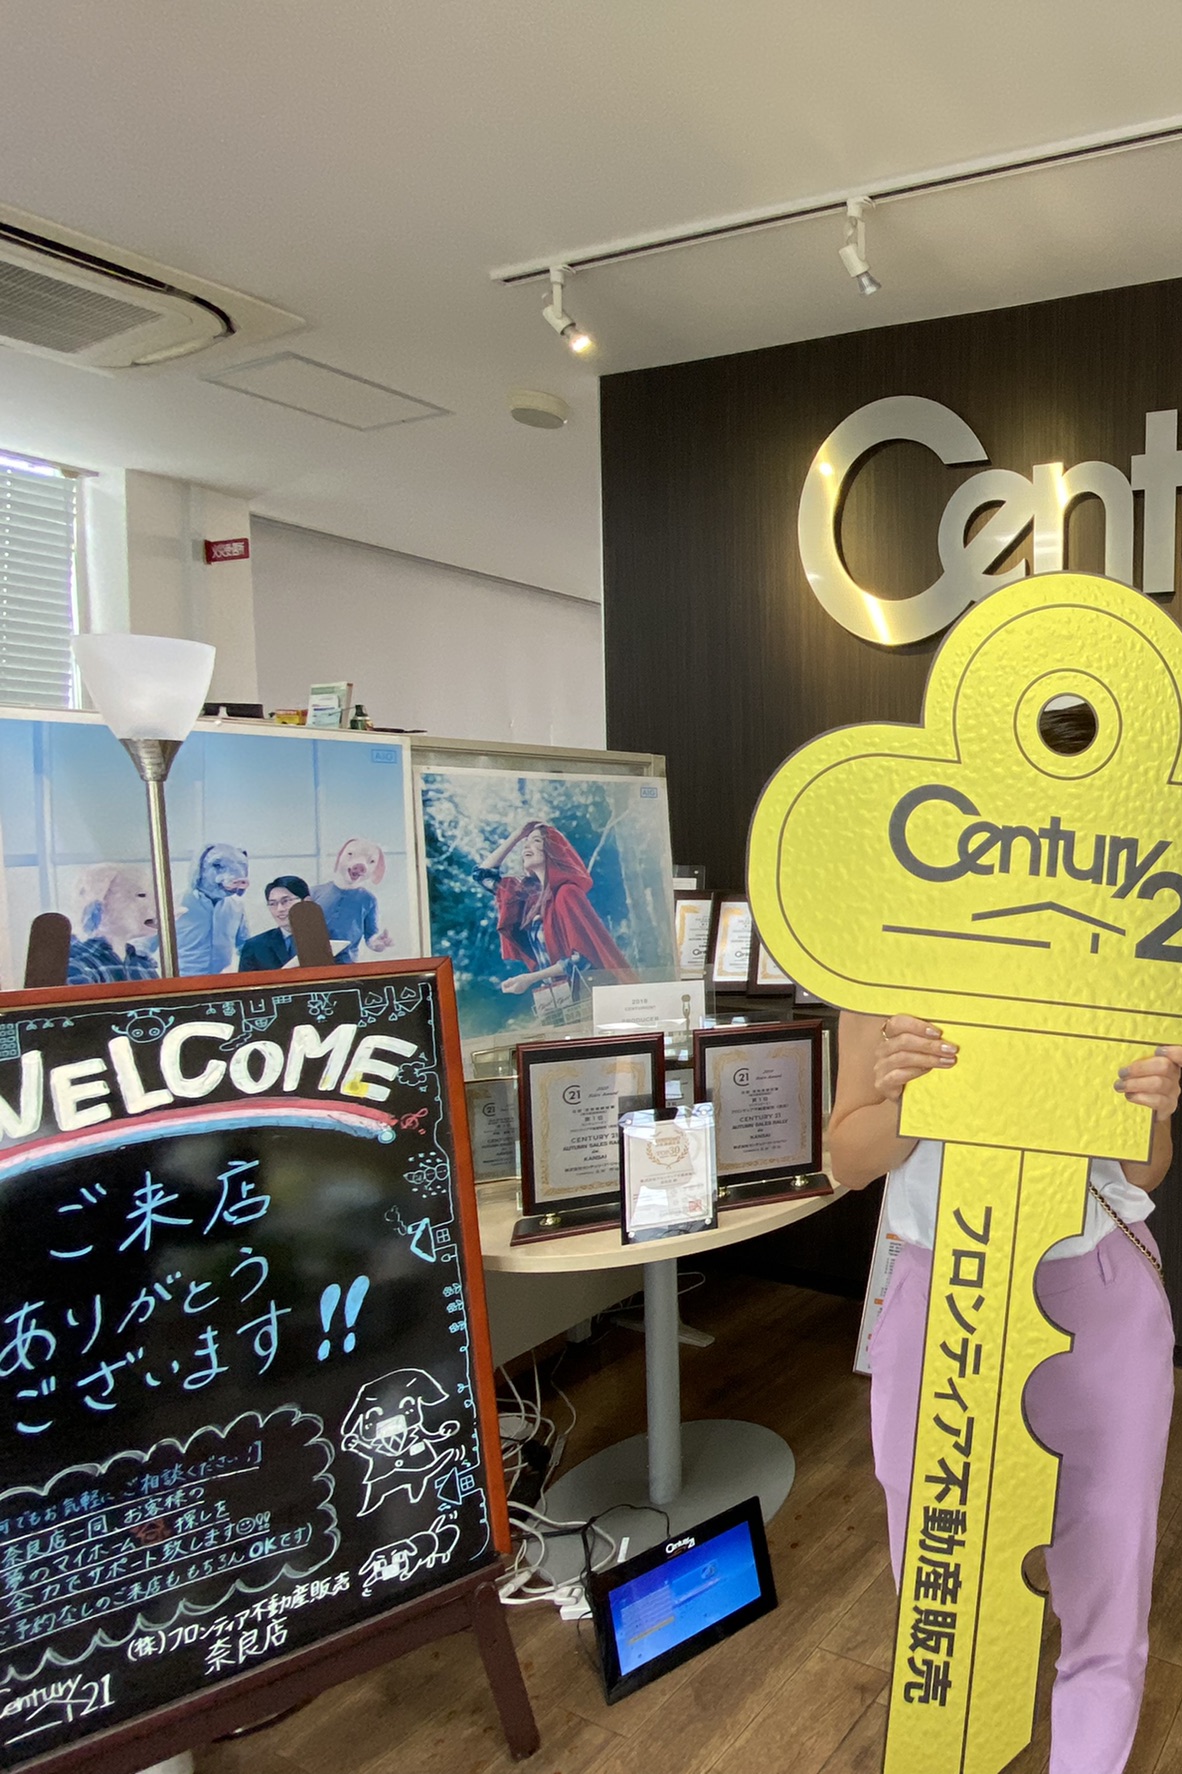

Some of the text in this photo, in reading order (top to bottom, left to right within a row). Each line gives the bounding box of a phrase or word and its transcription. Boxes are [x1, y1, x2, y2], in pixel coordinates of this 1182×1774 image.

[888, 784, 1173, 899] Century
[571, 1133, 609, 1144] CENTURY
[739, 1113, 773, 1123] CENTURY
[50, 1160, 271, 1258] ご来店
[0, 1247, 269, 1377] ありがとう
[903, 1205, 993, 1708] フロンティア不動産販売
[205, 1616, 288, 1676] 奈良店
[0, 1674, 83, 1720] entury
